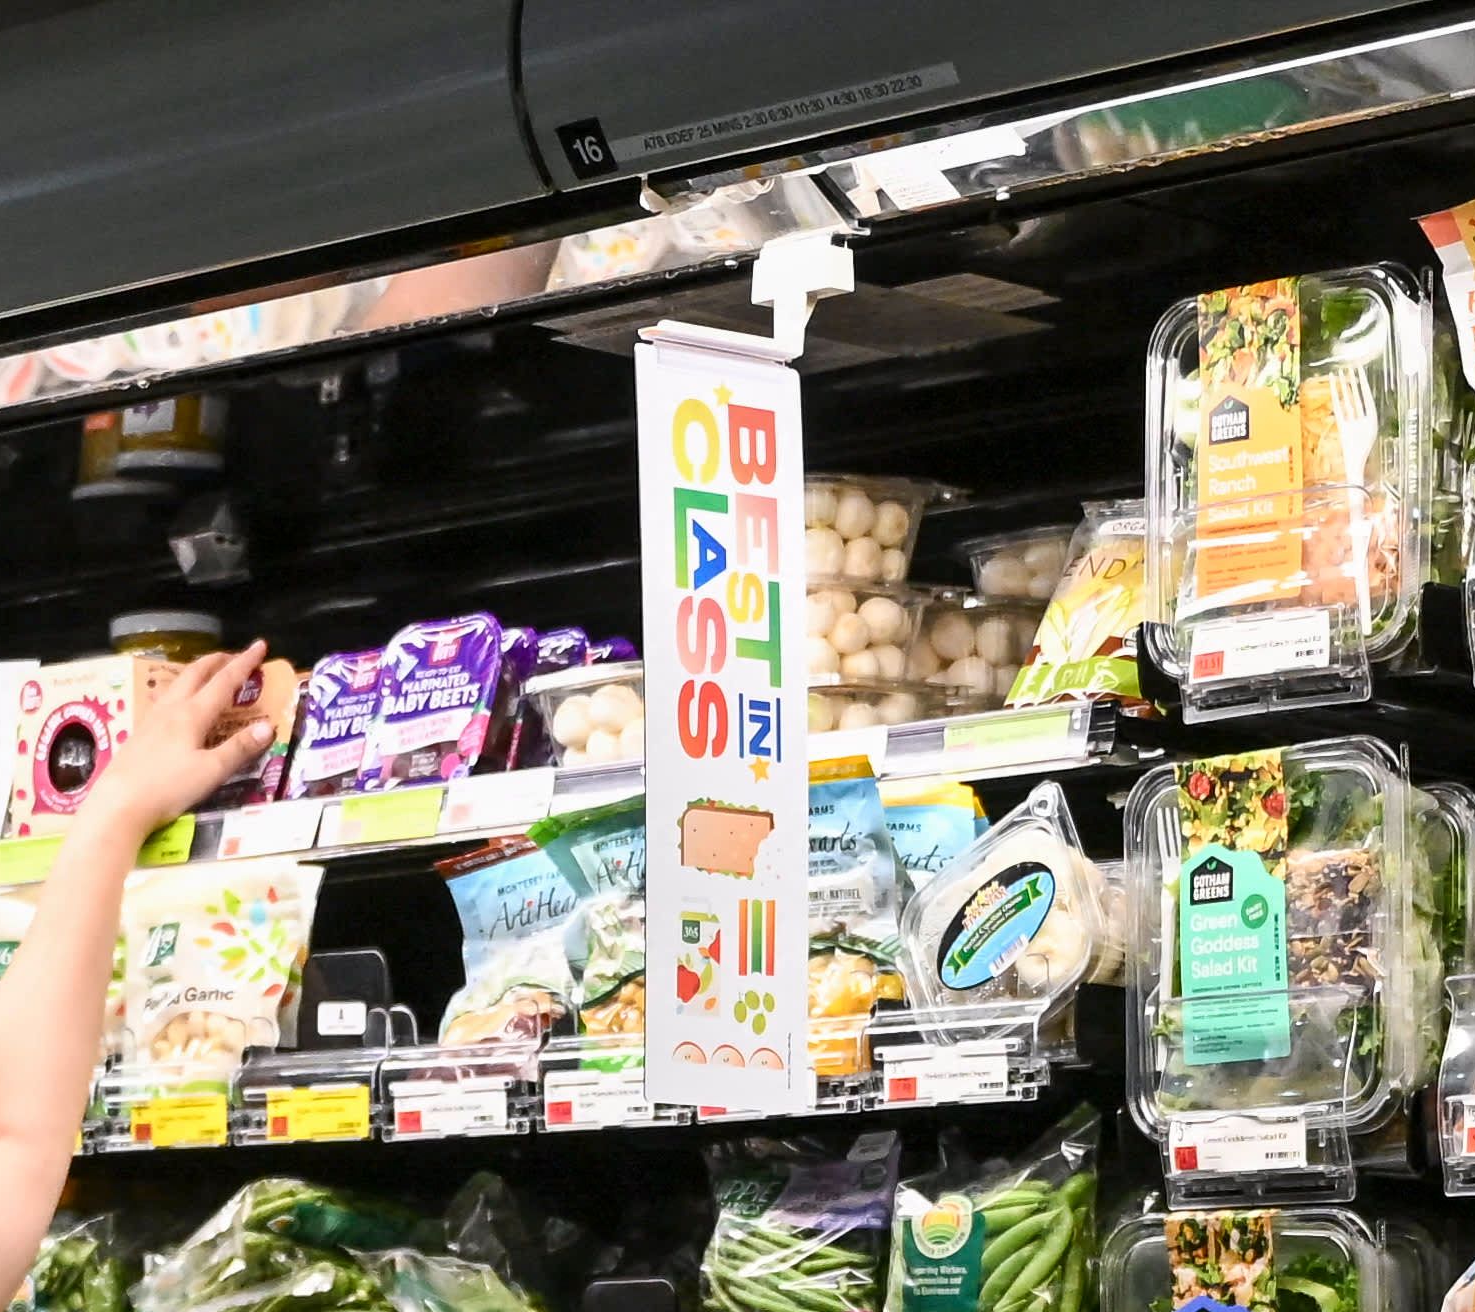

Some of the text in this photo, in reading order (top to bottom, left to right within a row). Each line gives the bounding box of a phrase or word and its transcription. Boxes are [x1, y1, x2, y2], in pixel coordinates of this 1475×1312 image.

[698, 126, 712, 141] 25
[713, 117, 743, 138] MINS
[573, 134, 603, 166] 16
[1212, 411, 1246, 426] GOTHAM
[1211, 424, 1247, 442] GREENS
[1209, 445, 1289, 474] Southwest
[1209, 477, 1257, 496] Ranch
[671, 396, 730, 761] CLASS
[725, 401, 782, 757] BEST IN
[401, 673, 469, 694] MARINATED
[383, 683, 481, 716] BABY BEETS
[1193, 874, 1230, 889] GOTHAM
[1193, 885, 1230, 901] GREENS
[1190, 913, 1238, 932] Green
[1190, 933, 1259, 954] Goddess
[1190, 955, 1258, 976] Salad Kit
